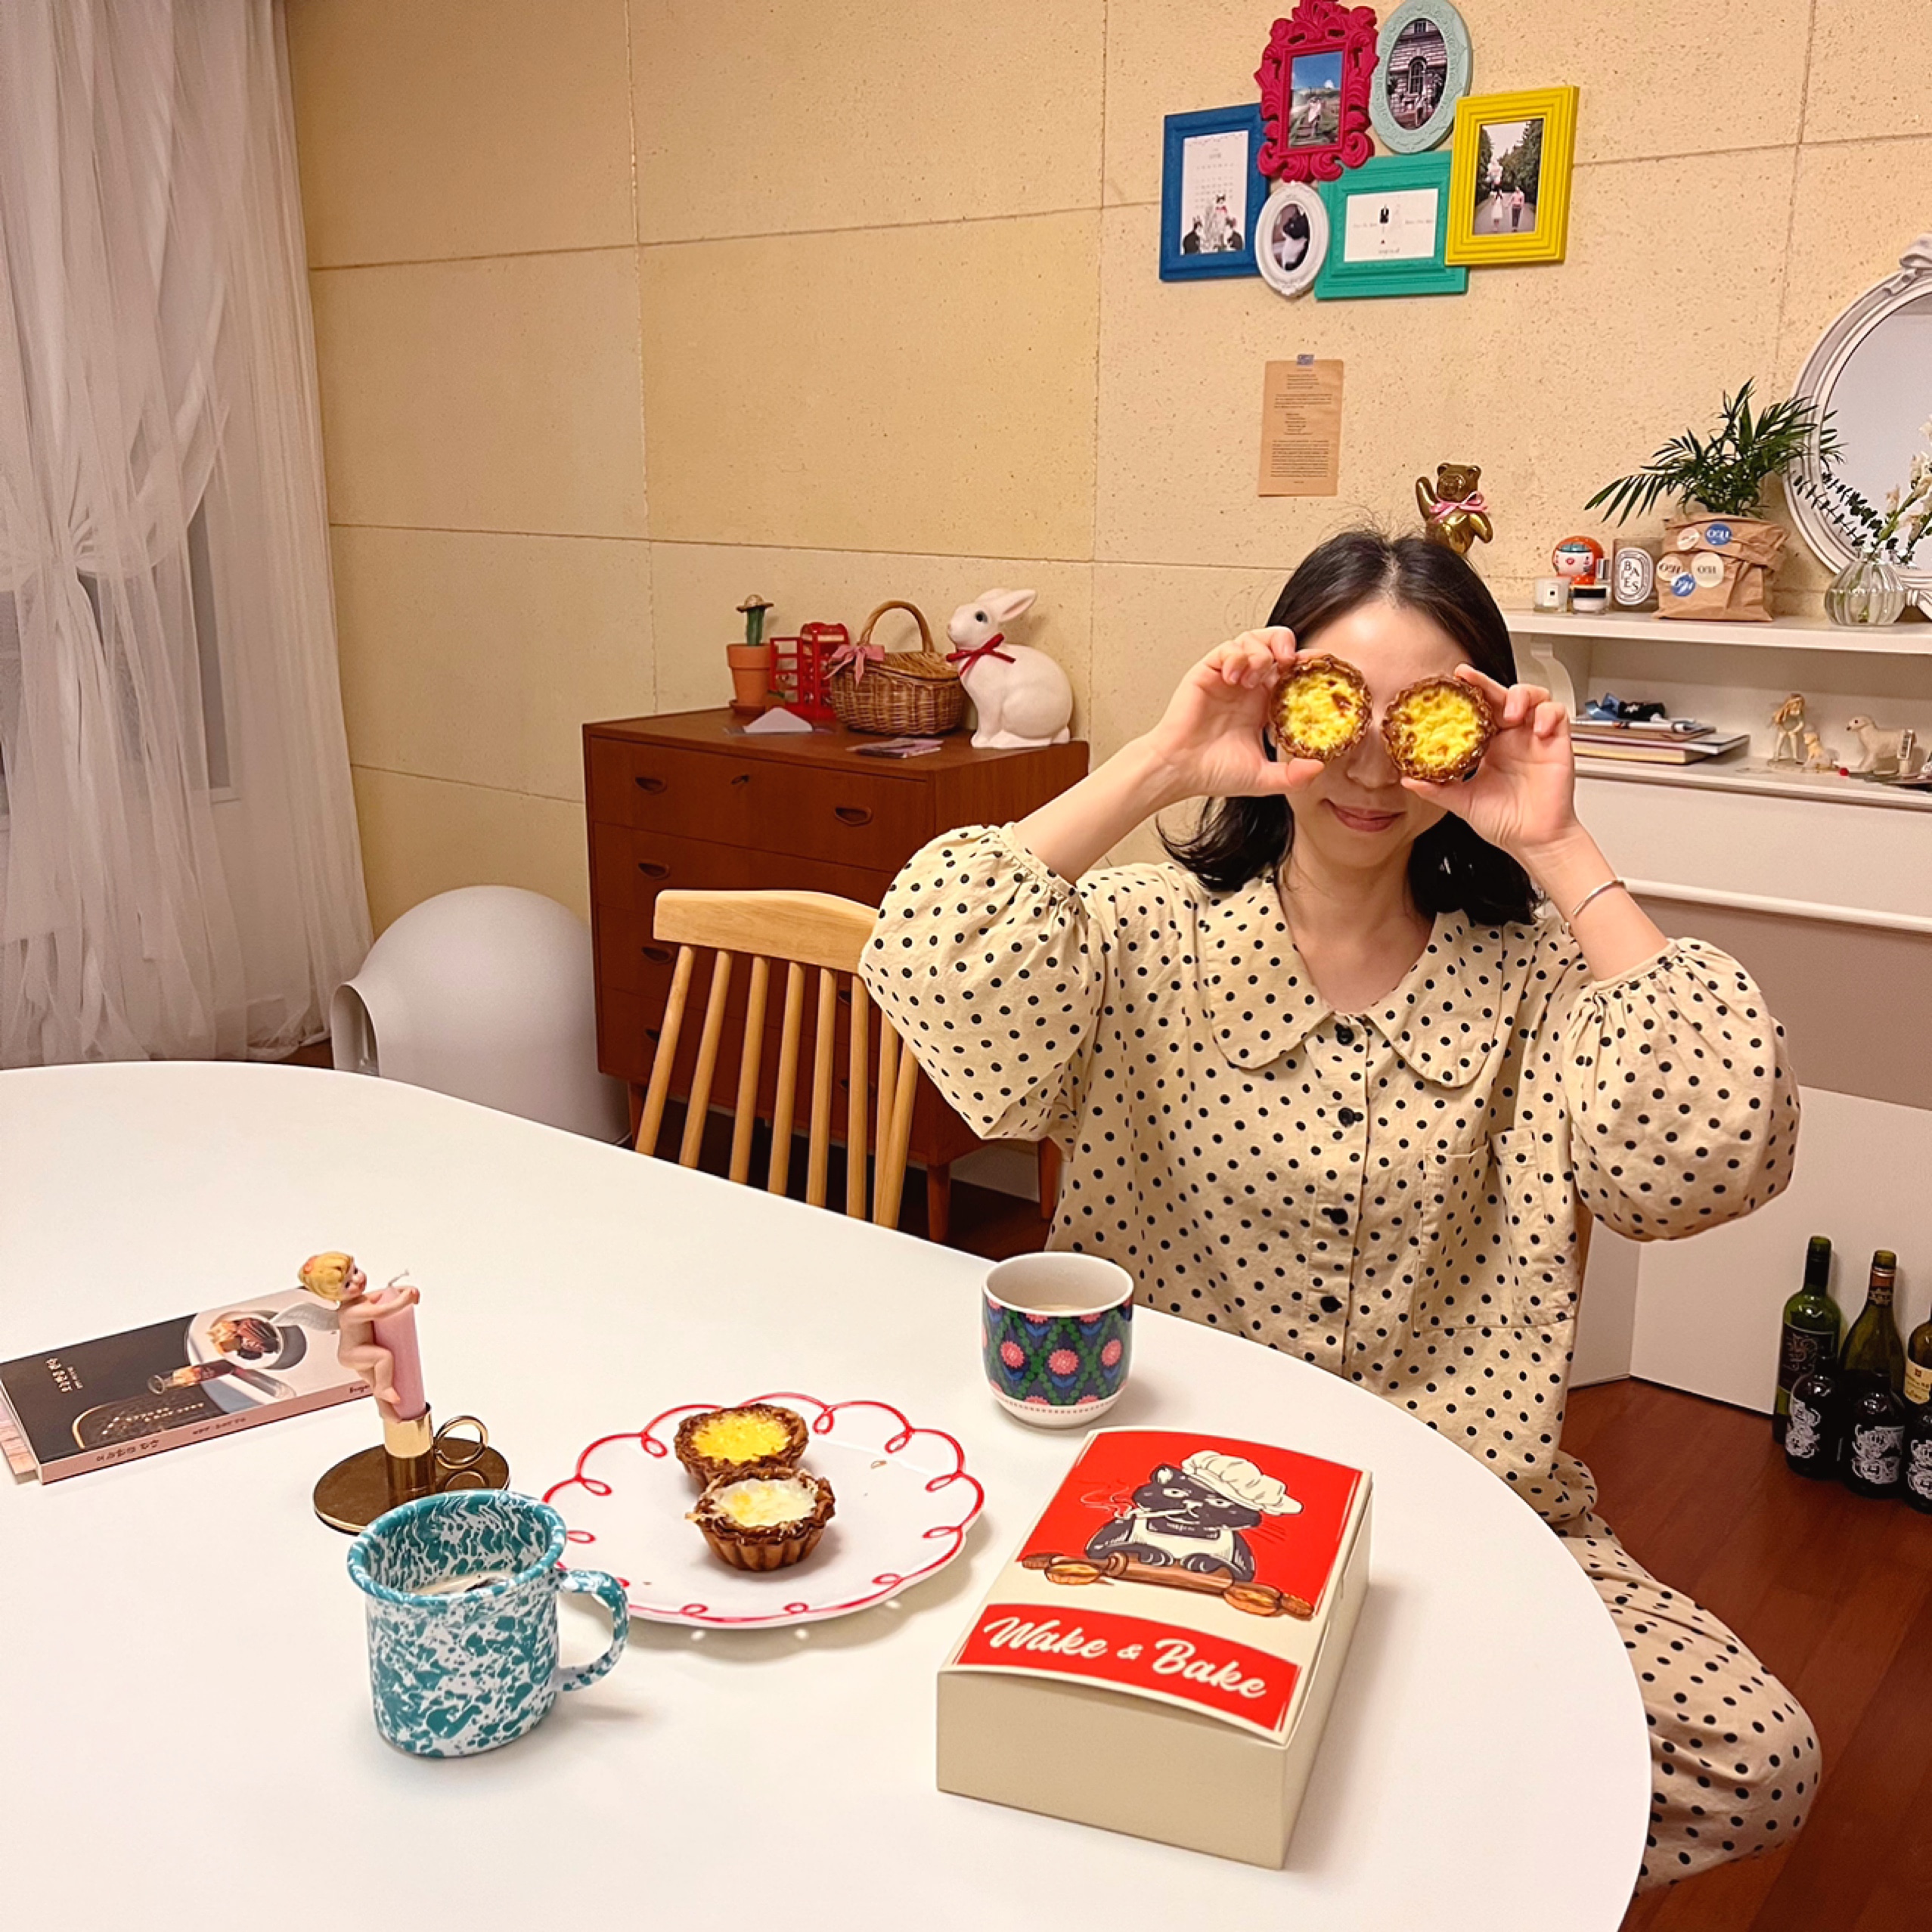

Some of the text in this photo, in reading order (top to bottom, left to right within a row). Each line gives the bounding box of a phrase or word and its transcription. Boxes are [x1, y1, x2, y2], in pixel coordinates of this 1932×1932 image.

[984, 1617, 1267, 1698] Wake & Bake
